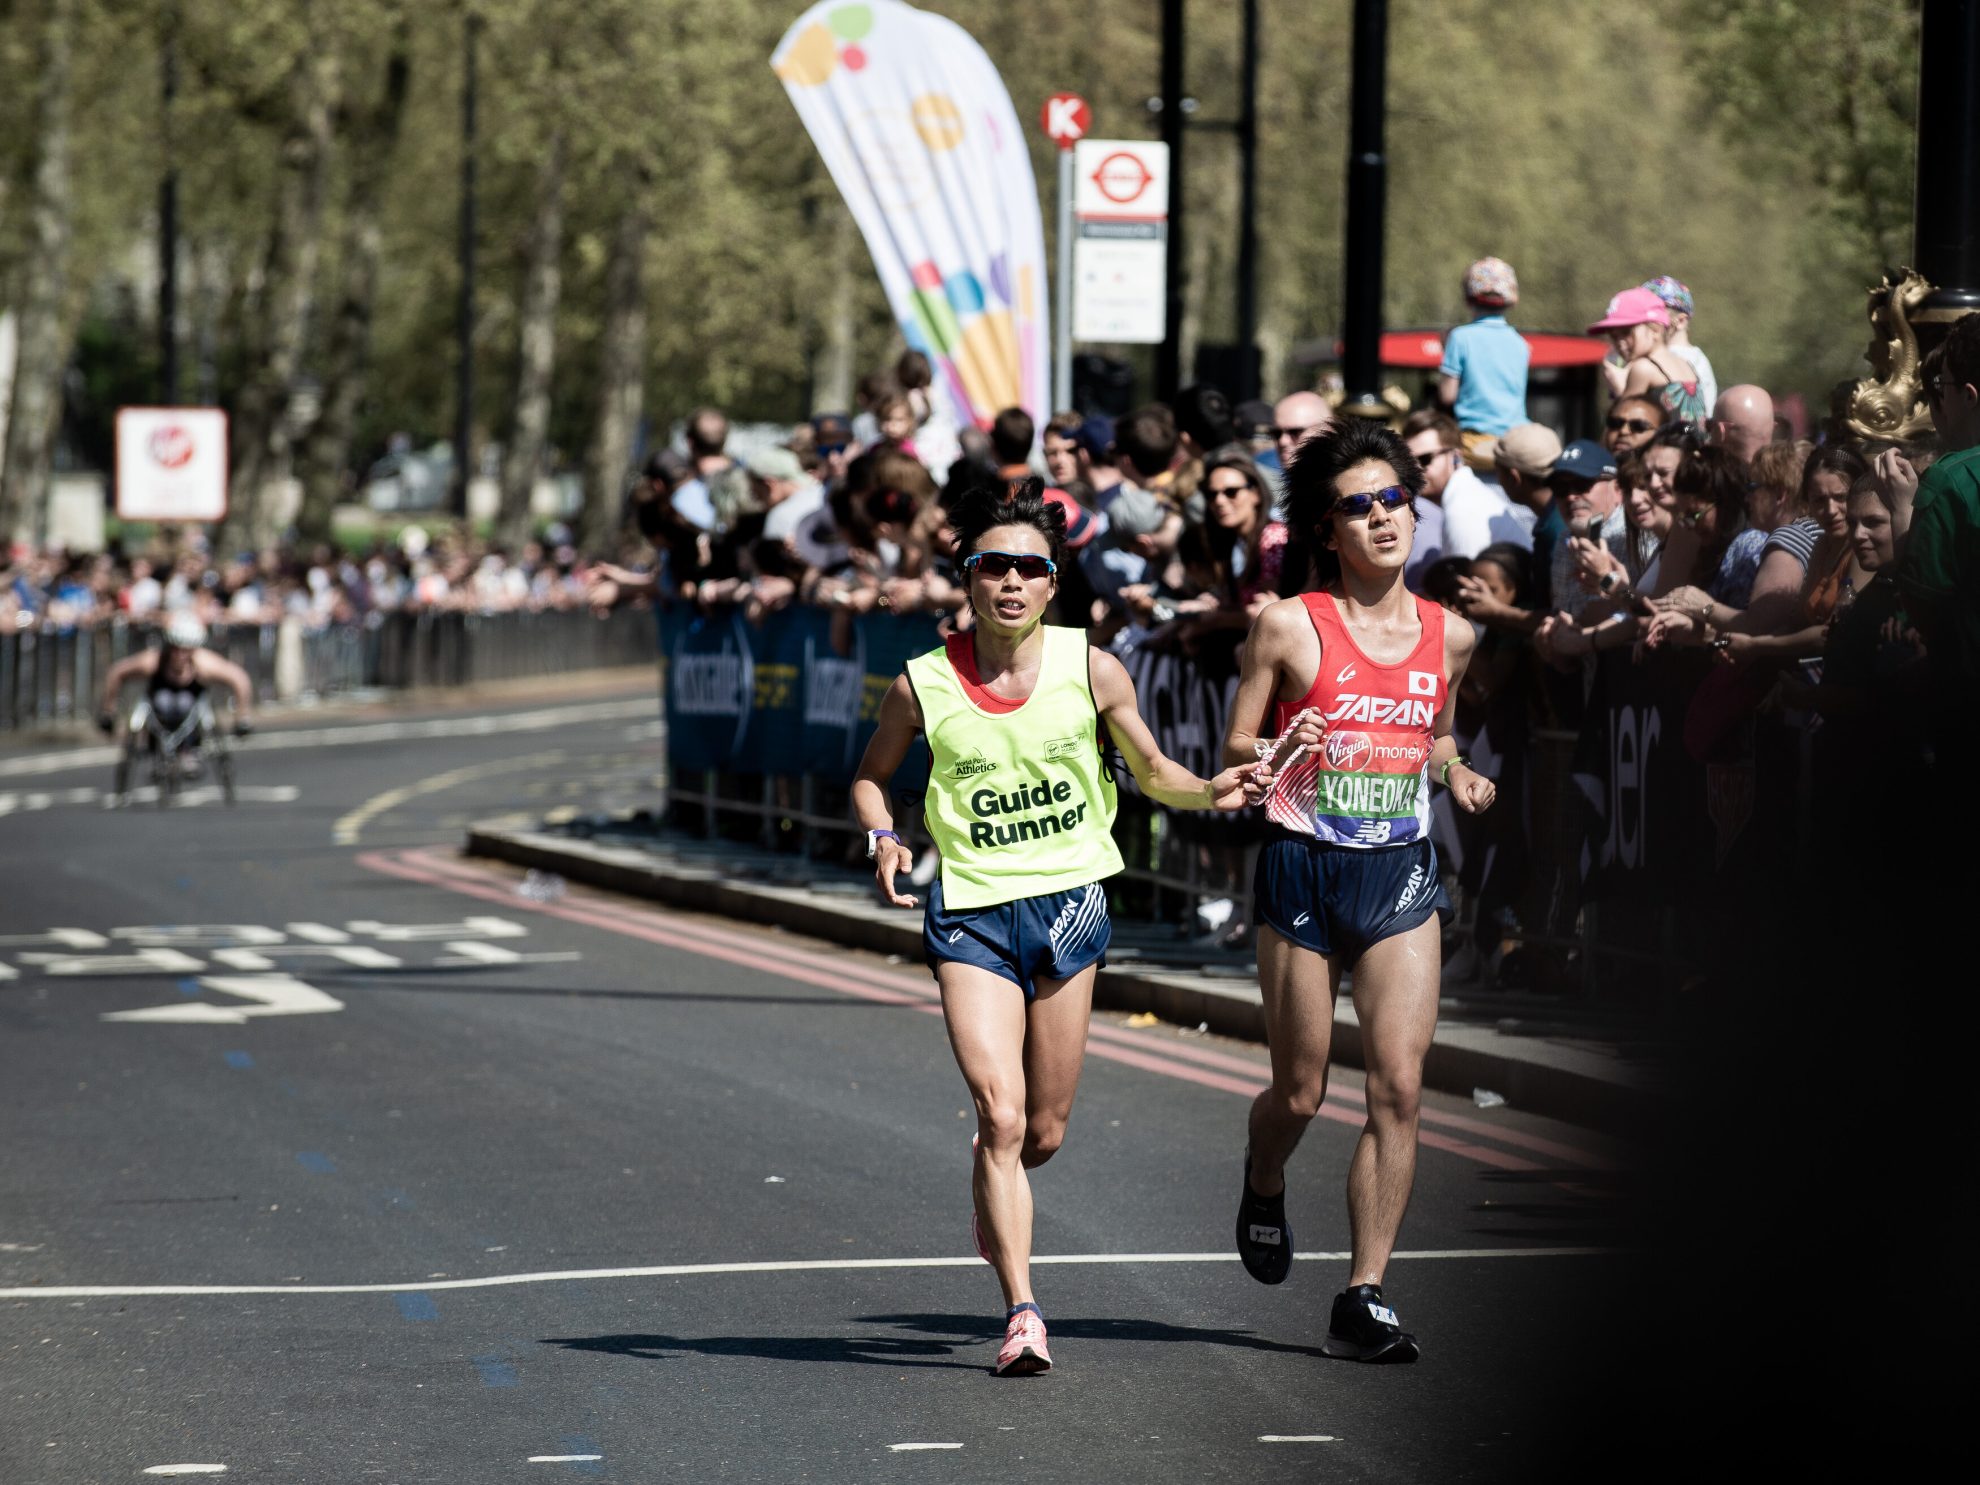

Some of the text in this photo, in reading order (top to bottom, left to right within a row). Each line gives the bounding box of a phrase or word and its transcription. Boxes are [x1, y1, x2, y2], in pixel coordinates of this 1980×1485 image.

[1049, 97, 1079, 138] K
[1325, 693, 1435, 728] JAPAN
[955, 760, 972, 768] World
[1328, 731, 1424, 768] Virgin money
[956, 763, 997, 776] Athletics
[971, 779, 1072, 818] Guide
[1324, 775, 1416, 813] YONEOKA
[969, 800, 1087, 849] Runner
